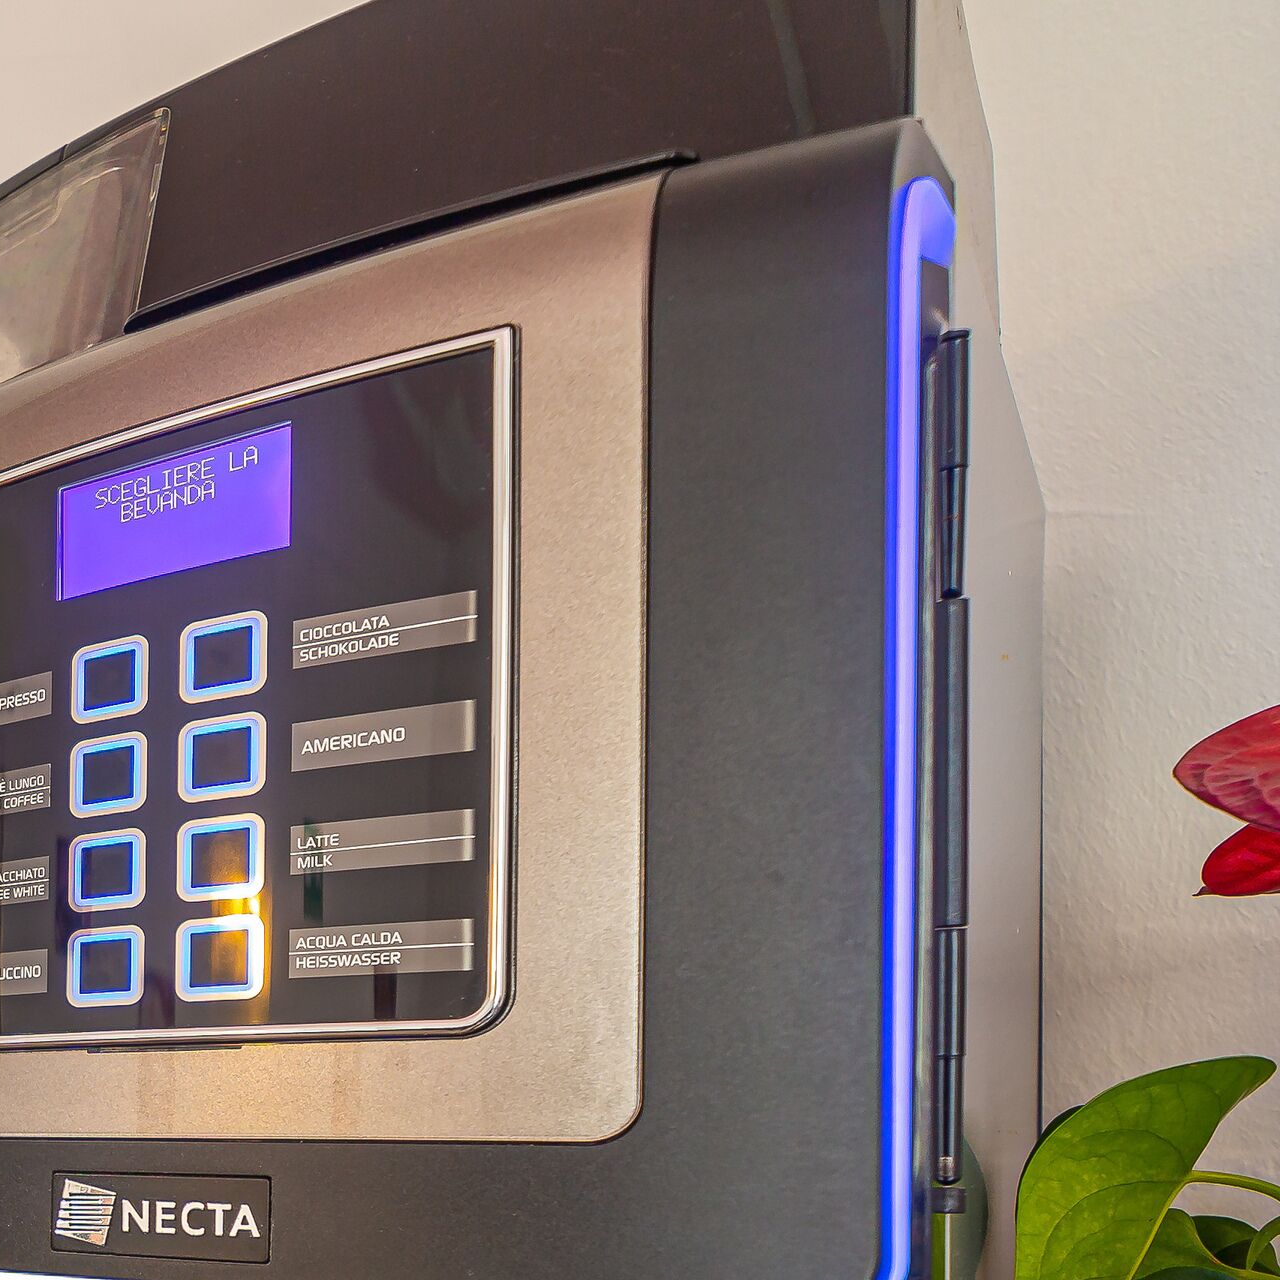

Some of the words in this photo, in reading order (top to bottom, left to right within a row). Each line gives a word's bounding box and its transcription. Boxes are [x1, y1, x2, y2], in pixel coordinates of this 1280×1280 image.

[95, 457, 215, 509] SCEGLIERE
[228, 446, 259, 472] LA
[120, 481, 215, 523] BEVANDA
[299, 615, 390, 642] CIOCCOLATA
[299, 633, 400, 662] SCHOKOLADE
[301, 727, 406, 755] AMERICANO
[9, 775, 44, 791] LUNGO
[4, 793, 44, 809] COFFEE
[297, 833, 340, 850] LATTE
[297, 854, 333, 869] MILK
[13, 884, 45, 898] WHITE
[296, 935, 347, 950] ACQUA
[351, 931, 403, 946] CALDA
[296, 951, 401, 969] HEISSWASSER
[121, 1199, 261, 1238] NECTA
